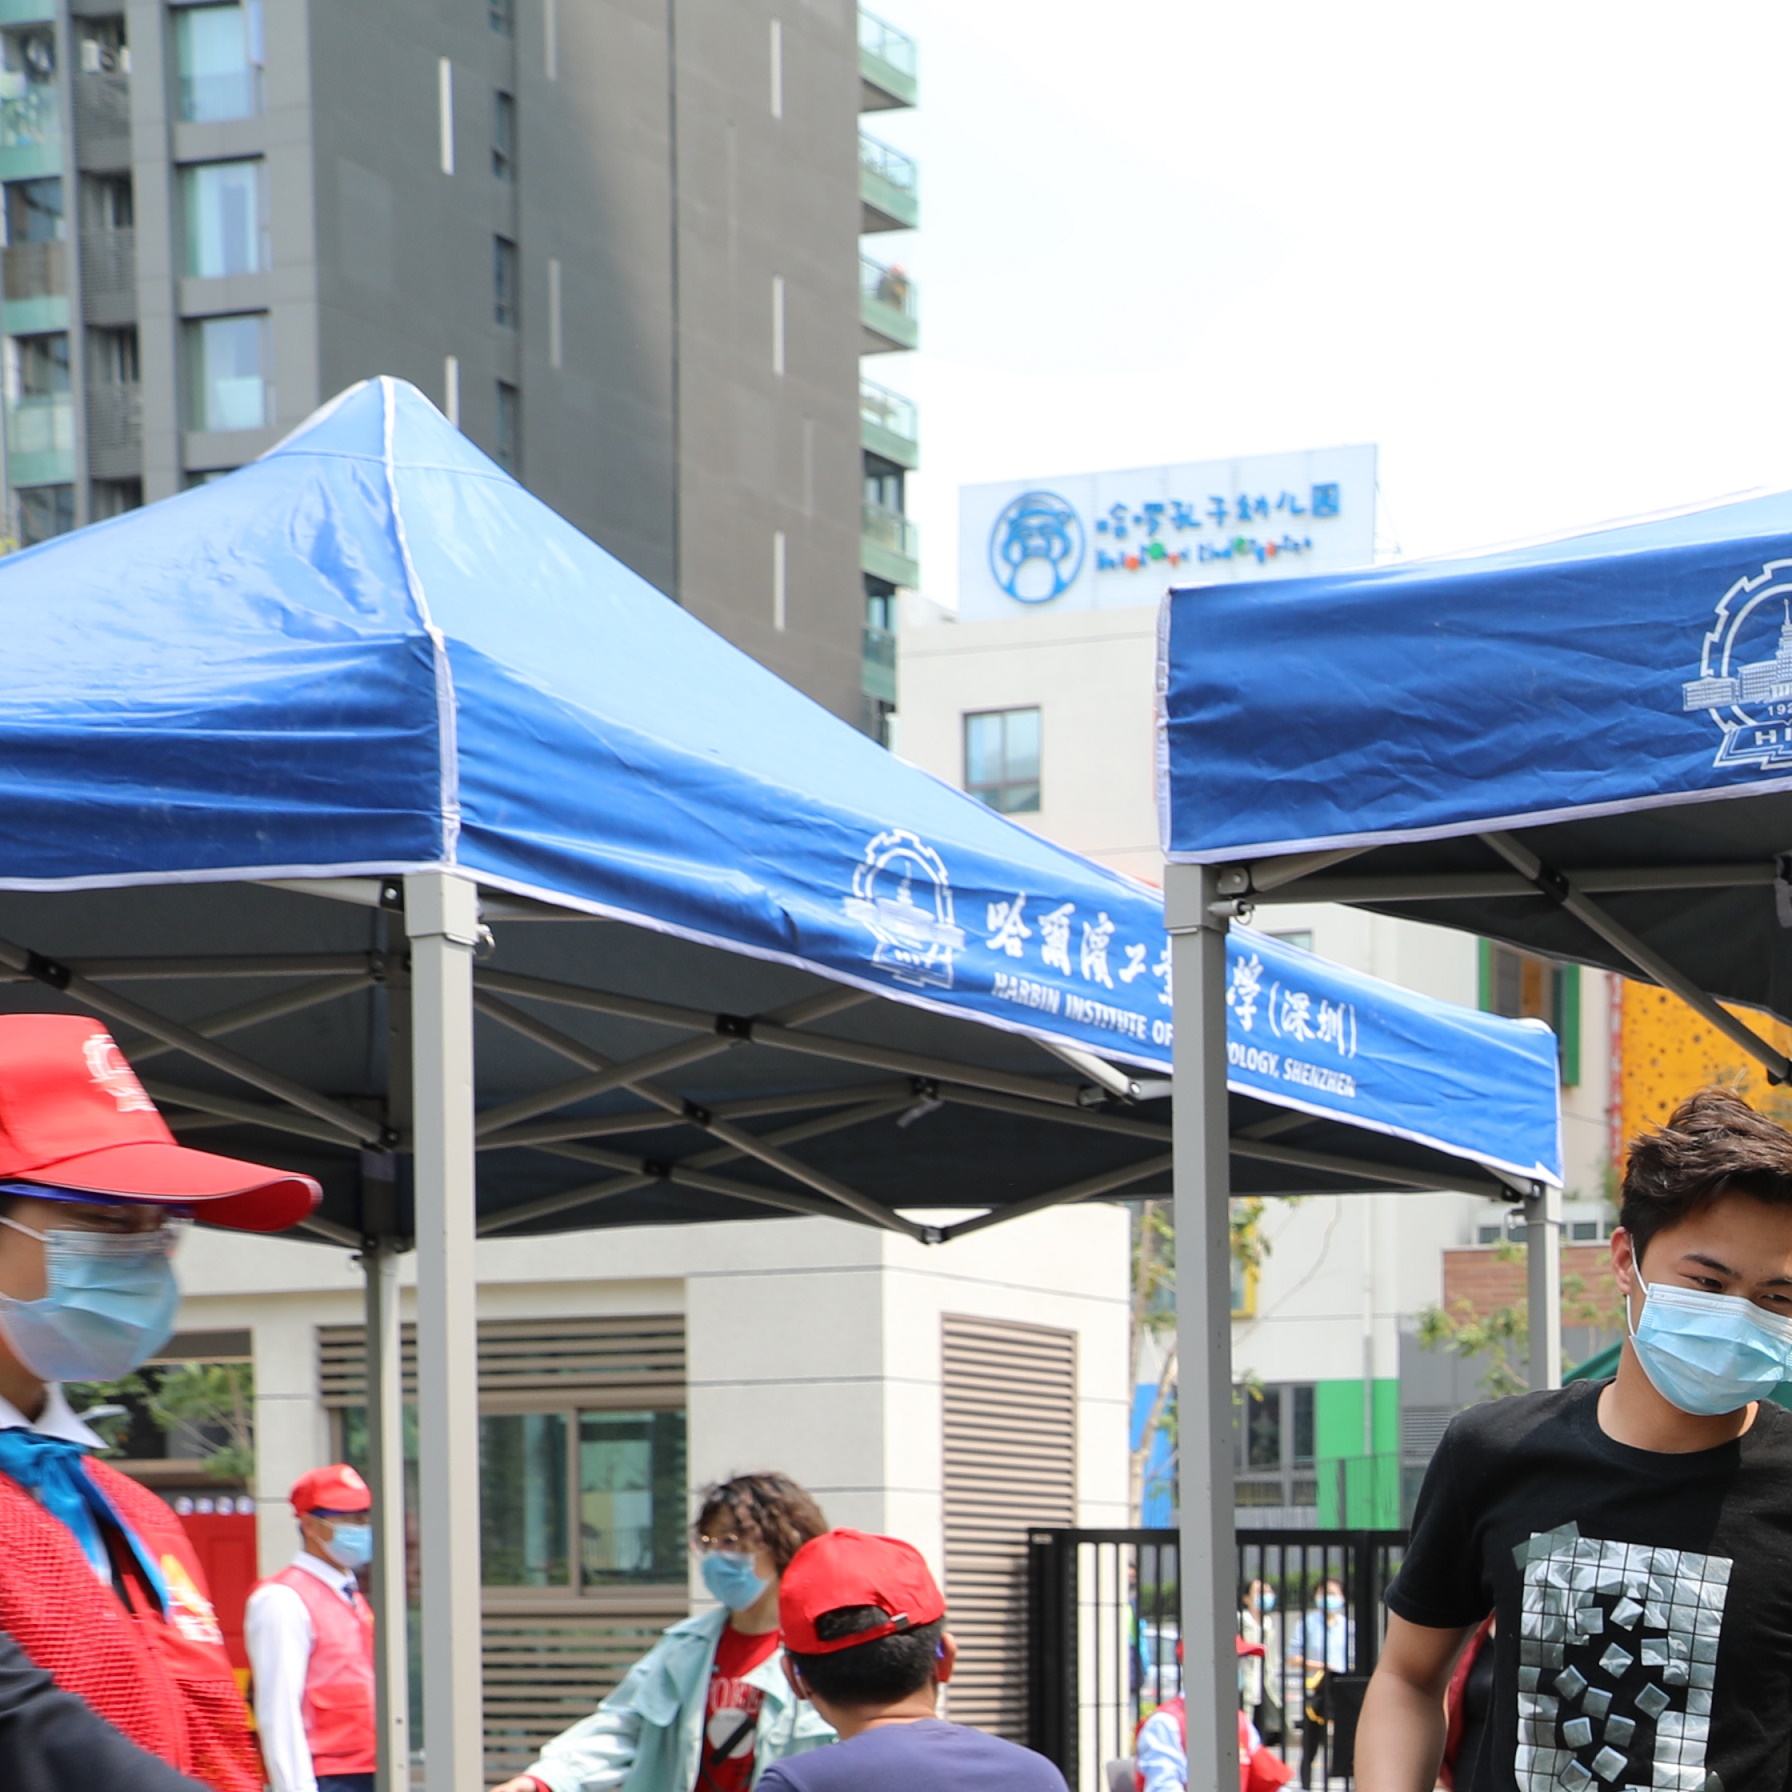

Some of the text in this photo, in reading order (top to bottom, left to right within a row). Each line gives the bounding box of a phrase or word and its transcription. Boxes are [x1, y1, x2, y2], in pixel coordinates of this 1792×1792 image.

[992, 971, 1061, 1015] HARBIN
[1065, 993, 1148, 1041] INSTITUTE
[1283, 1058, 1357, 1098] SHENZHEN
